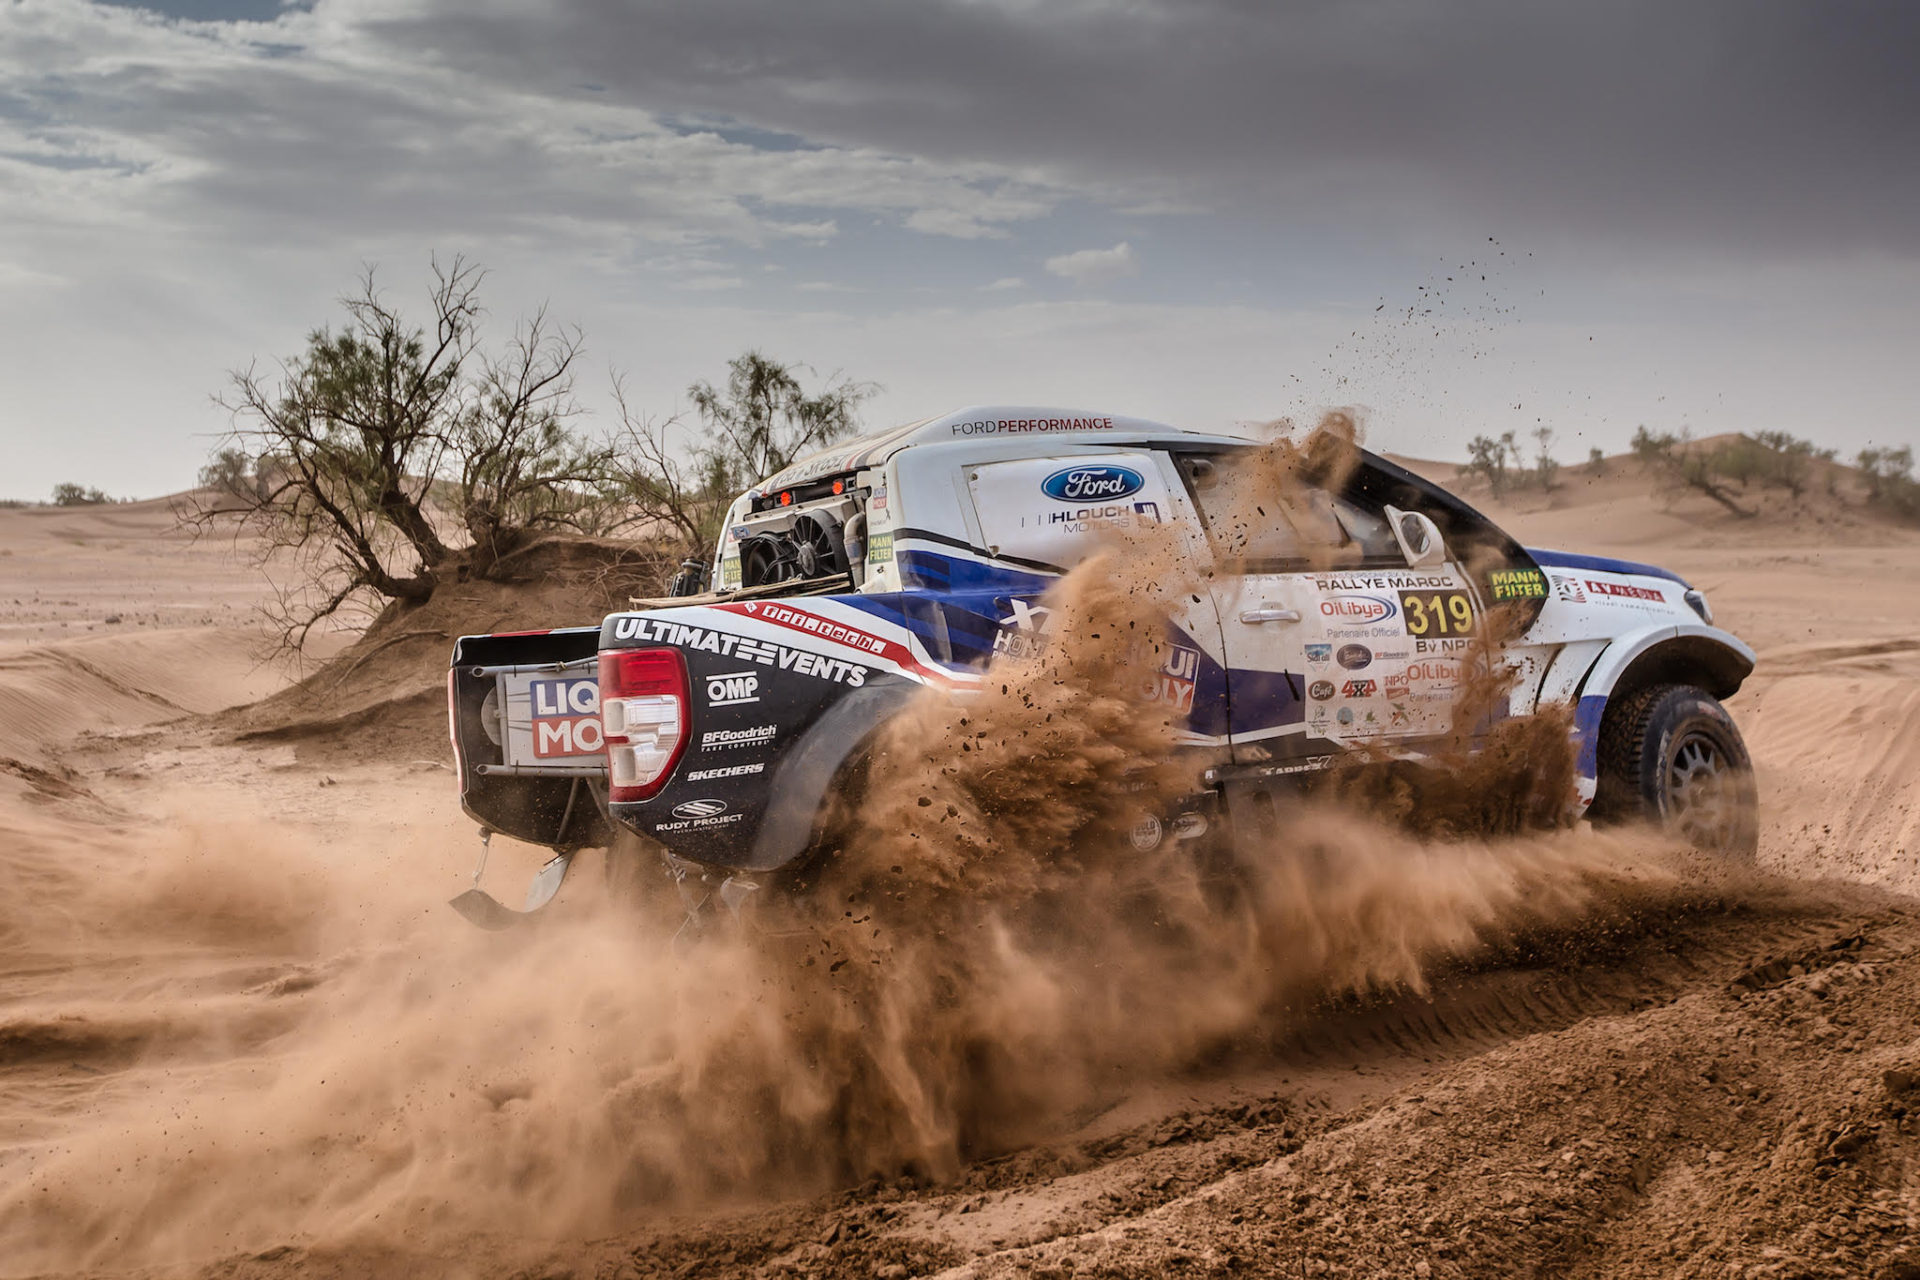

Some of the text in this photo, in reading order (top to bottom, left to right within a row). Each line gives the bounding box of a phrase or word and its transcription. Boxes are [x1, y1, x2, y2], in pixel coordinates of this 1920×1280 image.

[951, 417, 1113, 436] FORD PERFORMANCE
[1064, 469, 1126, 498] Ford
[1051, 505, 1130, 524] HLOUCH
[869, 536, 893, 548] MANN
[869, 549, 892, 561] FILTER
[1316, 576, 1453, 591] RALLYE MAROC
[1491, 570, 1540, 586] MANN
[1494, 583, 1544, 599] FILTER
[1403, 595, 1474, 635] 319
[1327, 627, 1400, 639] Partenaire Officiel
[1407, 664, 1460, 682] OiLiby
[535, 680, 601, 716] LIQ
[707, 676, 759, 702] OMP
[538, 717, 605, 754] MO
[702, 724, 776, 743] BFGoodrich
[687, 763, 765, 782] SKECHERS
[656, 813, 743, 831] RUDY PROJECT
